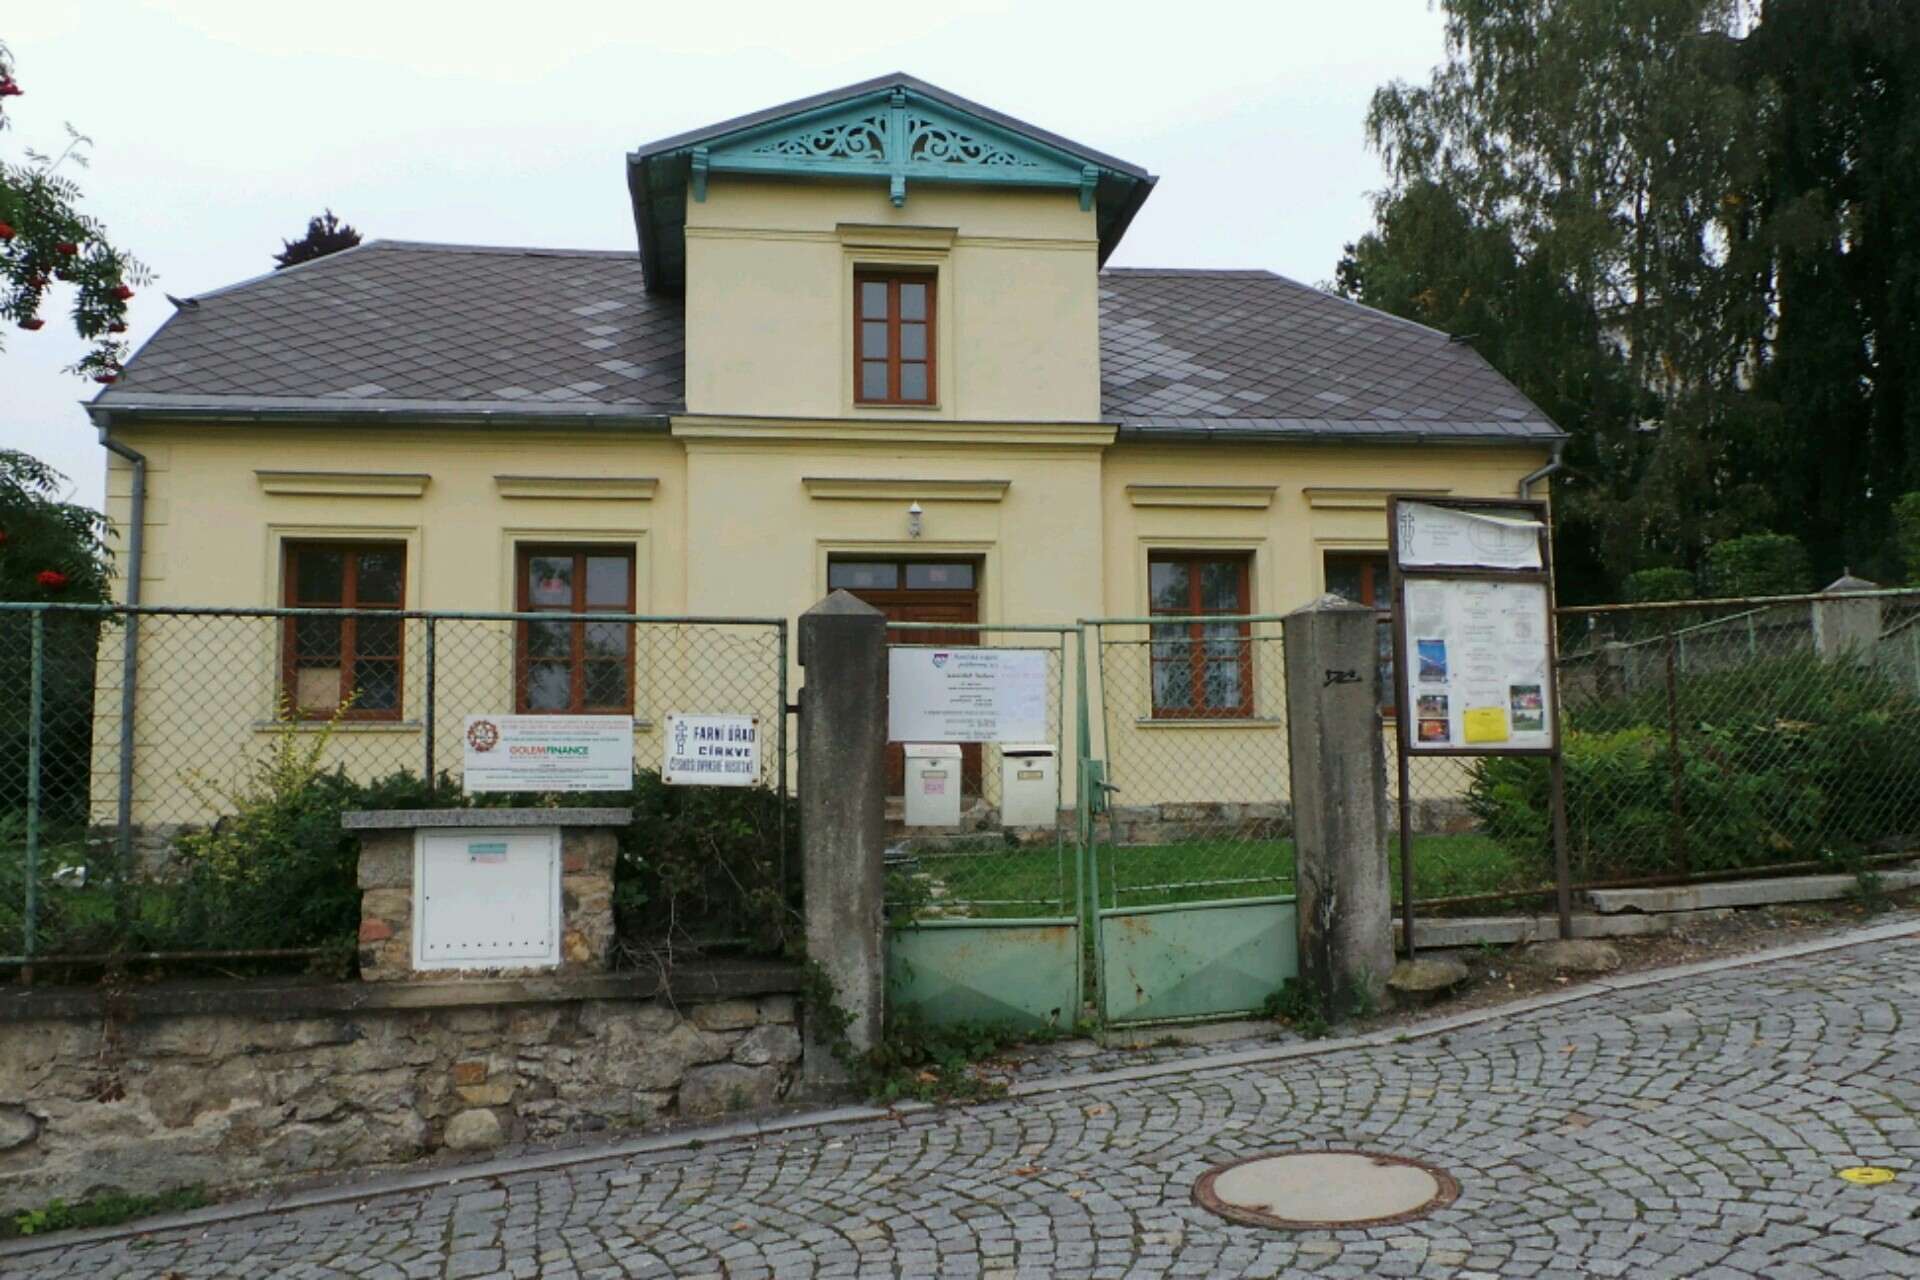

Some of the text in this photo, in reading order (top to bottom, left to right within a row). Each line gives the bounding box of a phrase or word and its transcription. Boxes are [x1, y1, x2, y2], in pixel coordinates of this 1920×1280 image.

[694, 724, 755, 743] FARNÍ ÚŘAD
[699, 744, 751, 757] CÍRKVE
